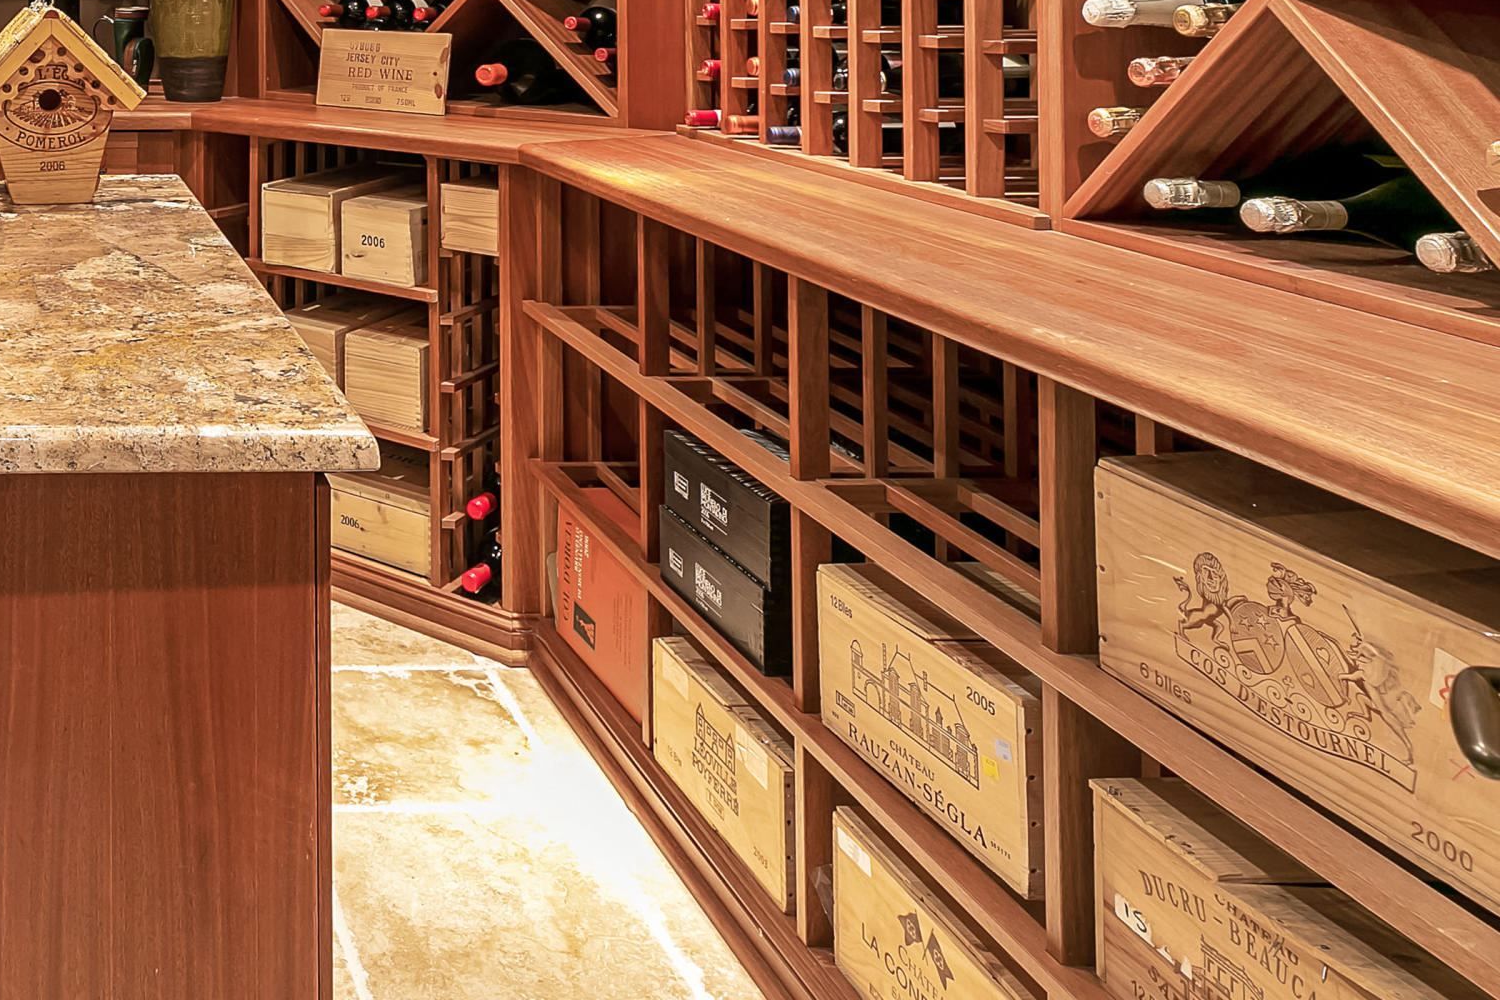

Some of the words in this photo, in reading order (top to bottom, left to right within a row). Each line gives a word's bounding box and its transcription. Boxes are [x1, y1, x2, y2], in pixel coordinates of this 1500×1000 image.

[346, 52, 377, 65] JERSEY
[381, 55, 401, 67] CITY
[348, 66, 373, 79] RED
[379, 68, 414, 81] WINE
[15, 131, 86, 150] POMEROL
[40, 161, 66, 171] 2006
[361, 234, 386, 250] 2006
[340, 514, 360, 530] 2006
[1139, 662, 1150, 679] 6
[966, 686, 996, 716] 2005
[1190, 648, 1227, 687] COS
[1236, 684, 1392, 774] D'ESTOURNEL
[889, 739, 935, 782] CHÂTEAU
[849, 722, 988, 850] RAUZAN-SÉGLA
[1410, 820, 1474, 874] 2000
[861, 922, 880, 960] LA
